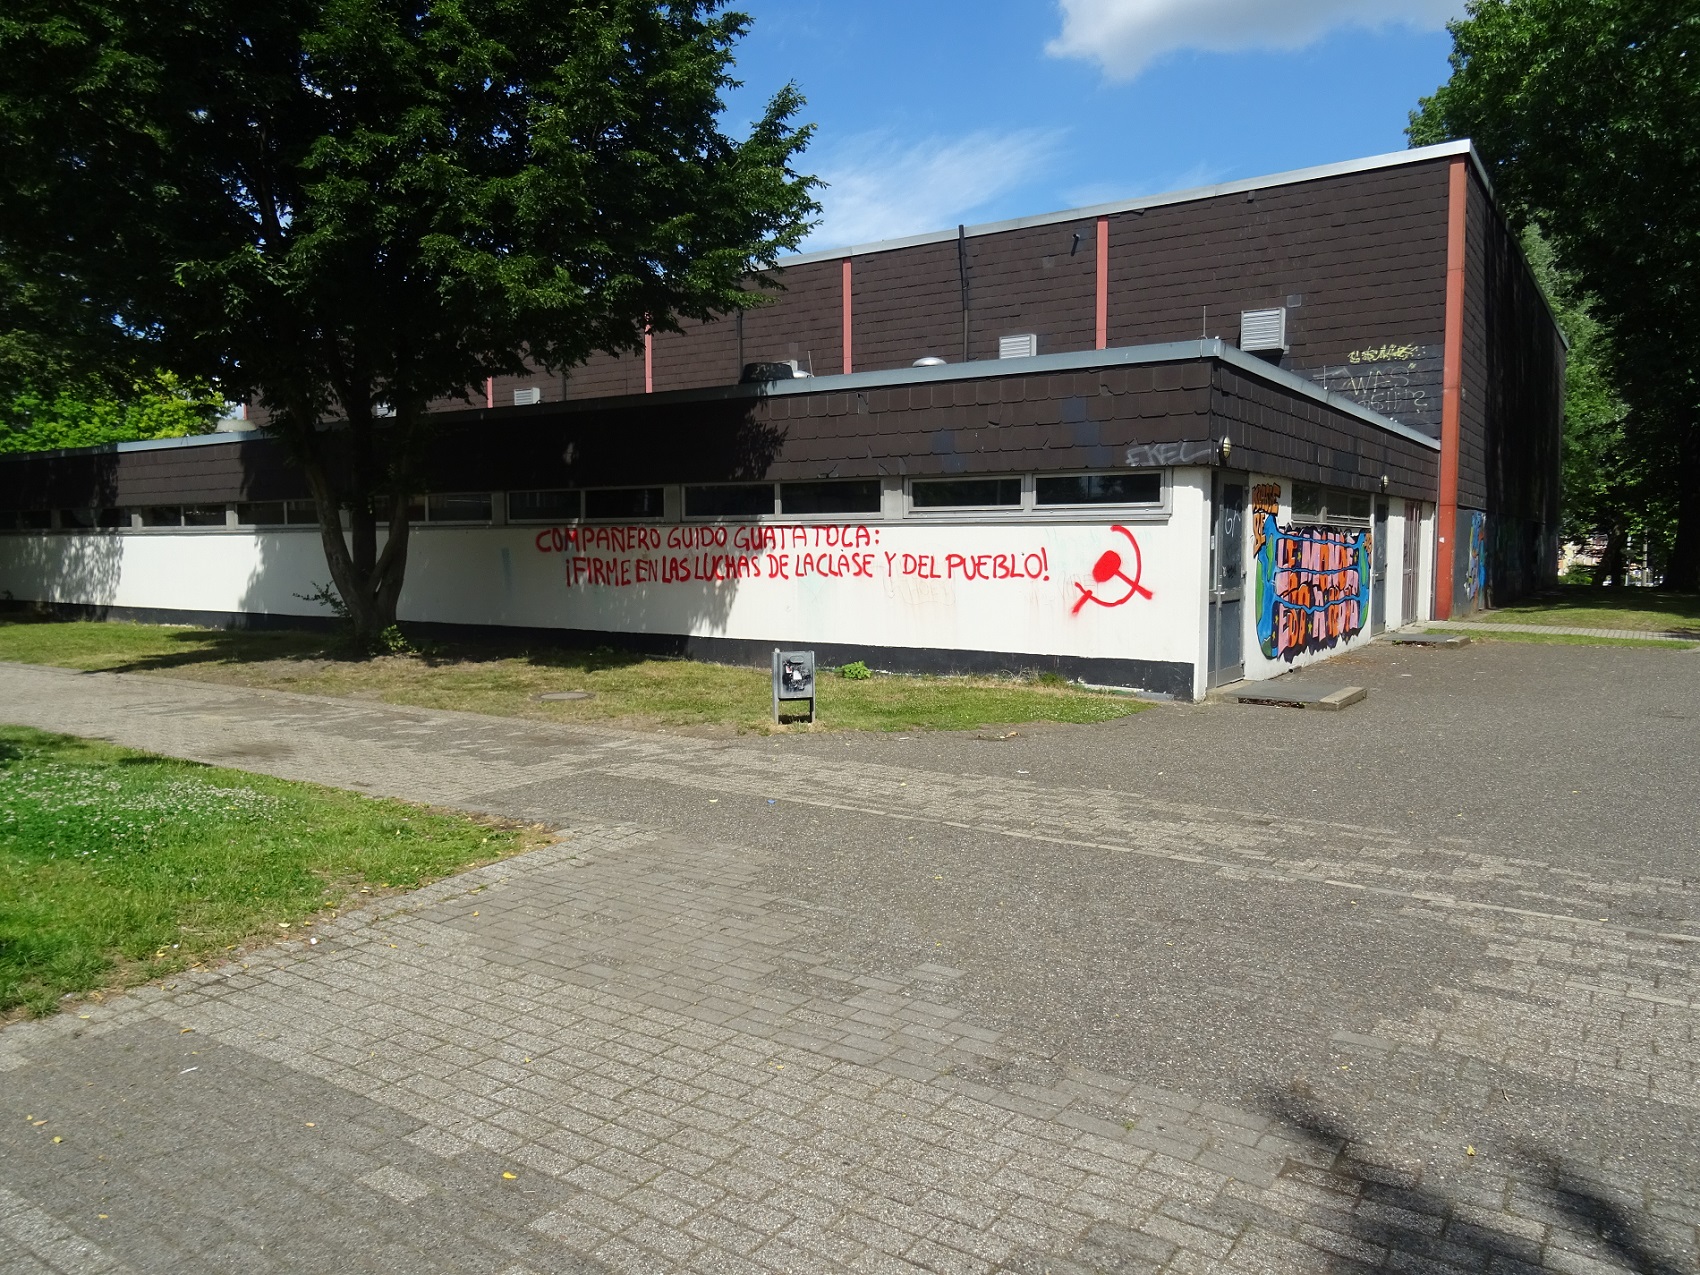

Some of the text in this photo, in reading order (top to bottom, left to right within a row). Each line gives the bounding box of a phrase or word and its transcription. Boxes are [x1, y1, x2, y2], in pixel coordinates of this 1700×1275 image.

[535, 526, 661, 552] COMPAÑERO
[667, 526, 728, 550] GUIDO
[566, 556, 632, 587] ¡FIRME
[636, 558, 658, 583] EN
[662, 555, 692, 584] LAS
[694, 553, 761, 581] LUCHAS
[766, 553, 789, 580] DE
[884, 551, 897, 578] Y
[902, 553, 942, 580] DEL
[945, 547, 1050, 582] PUEBLO!
